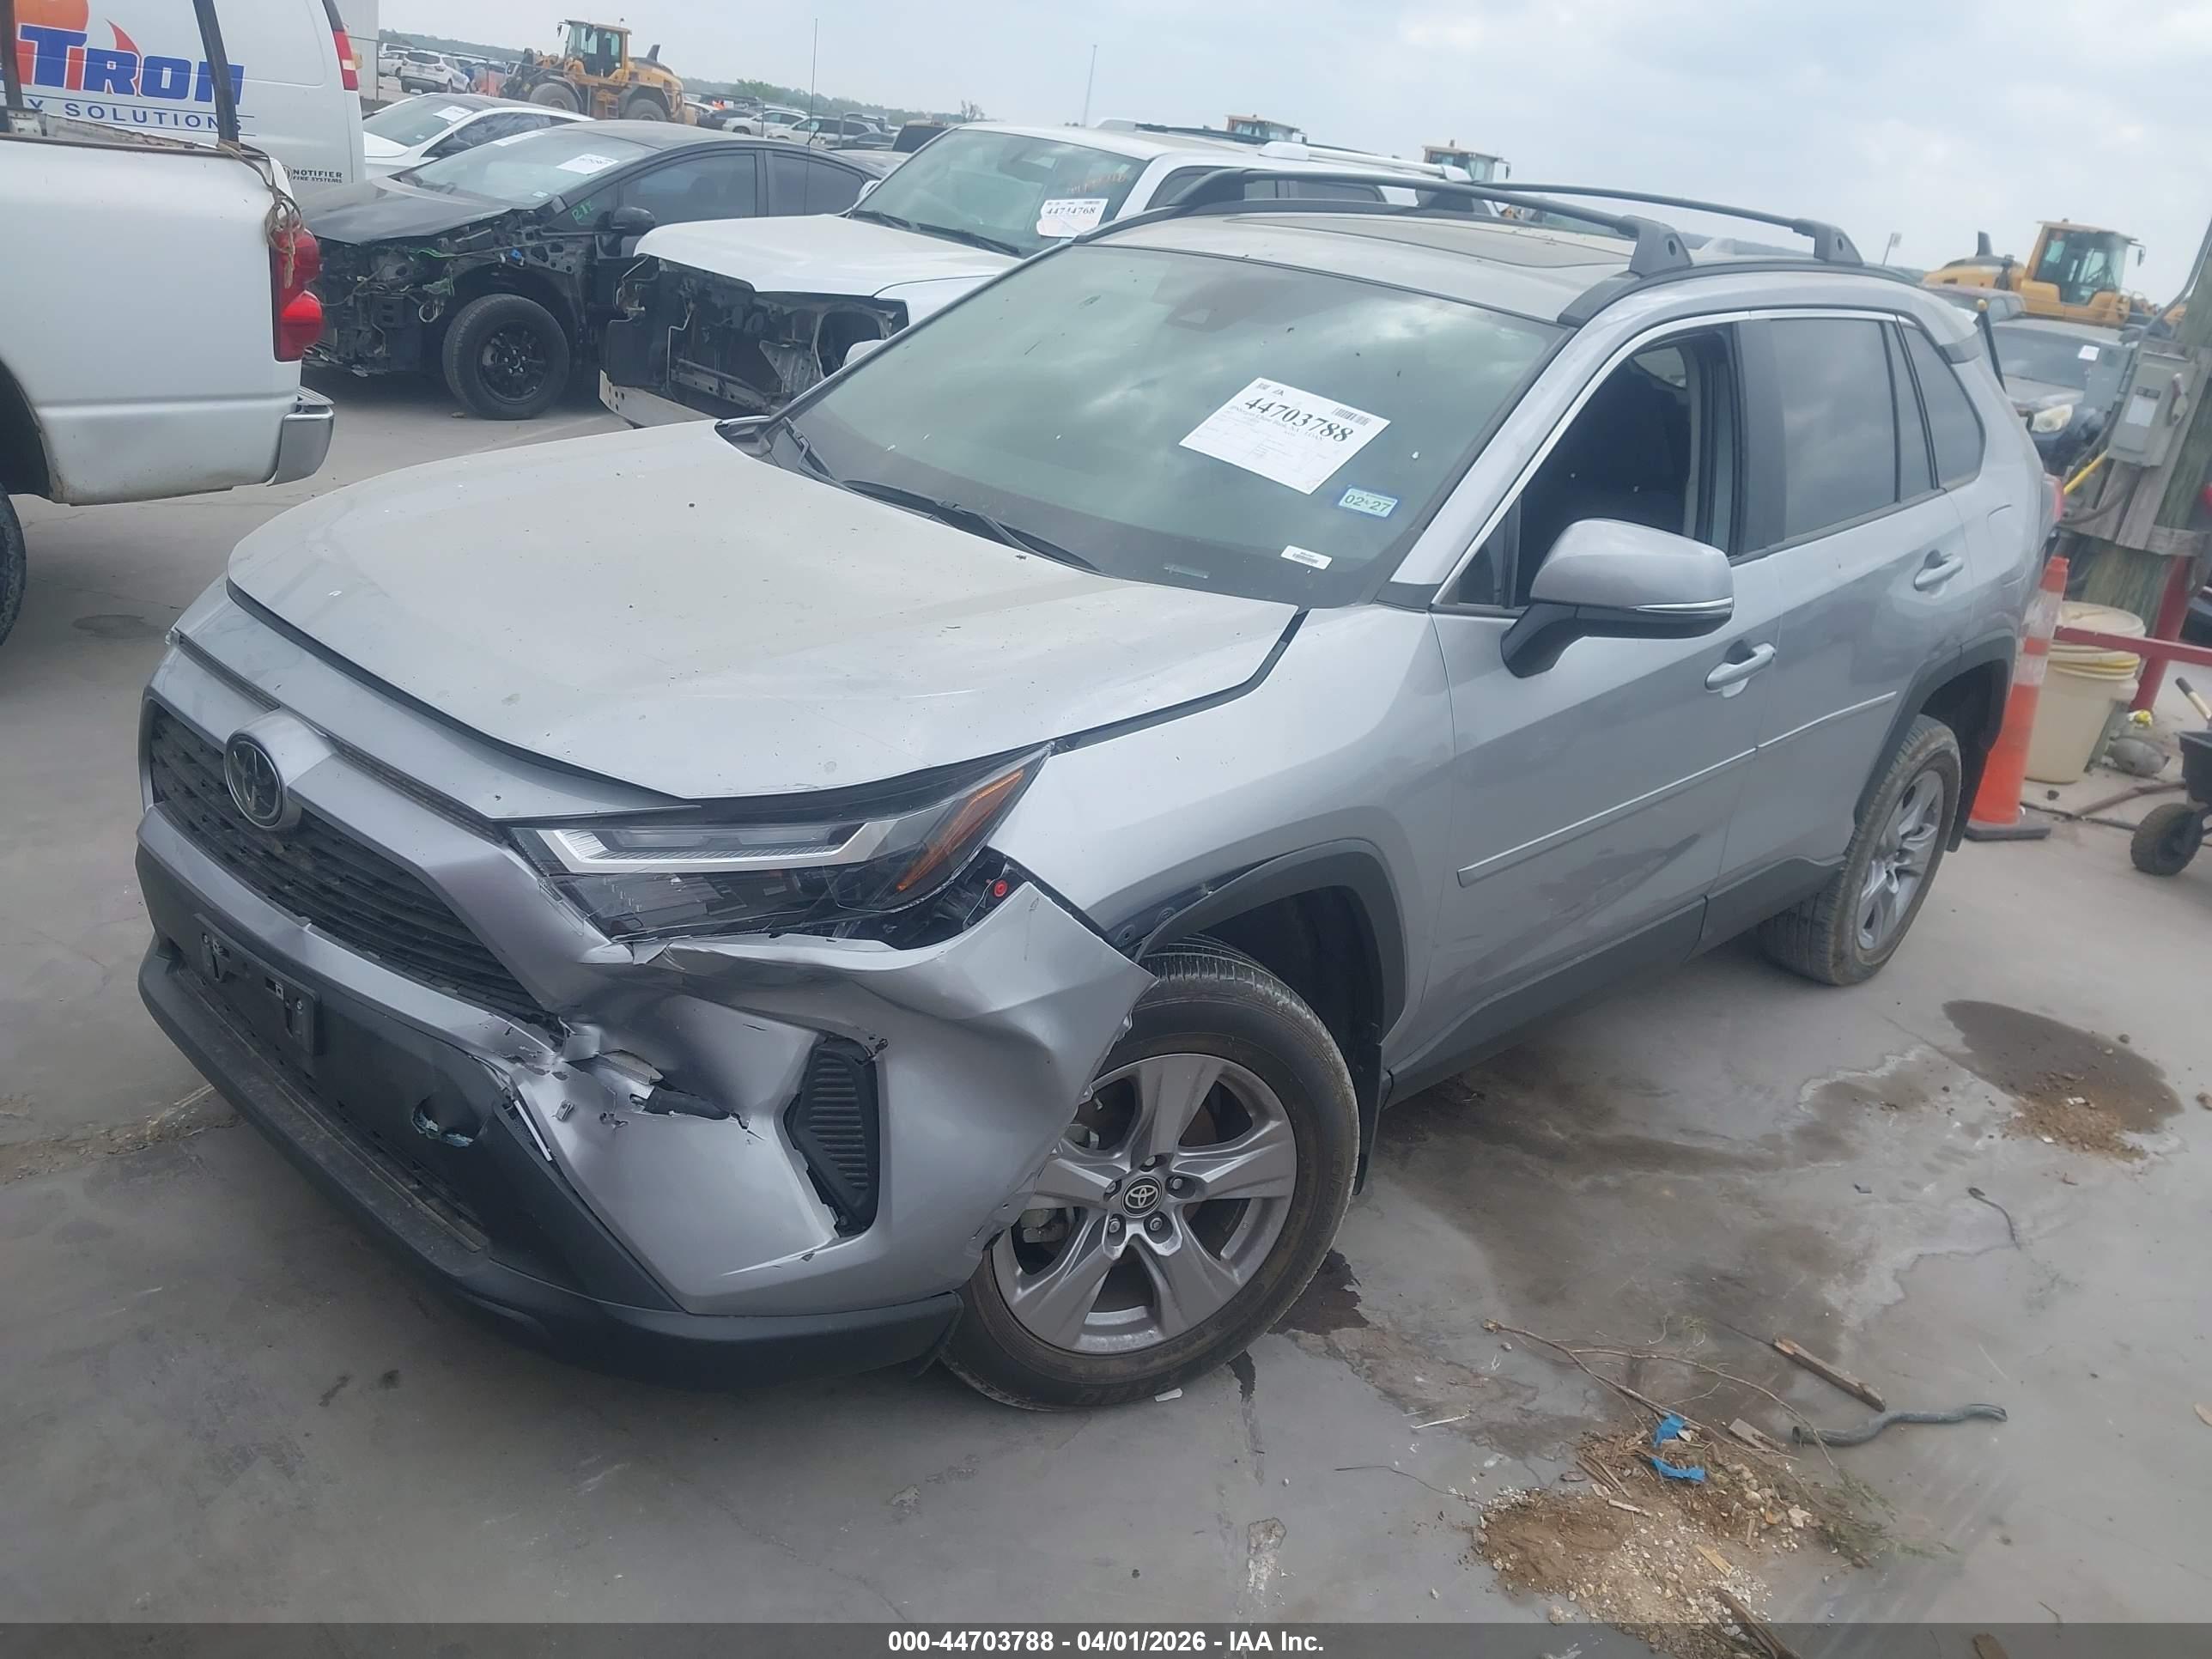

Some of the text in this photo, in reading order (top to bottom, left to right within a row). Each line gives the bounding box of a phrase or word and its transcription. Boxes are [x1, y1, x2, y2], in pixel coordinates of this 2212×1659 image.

[293, 169, 343, 179] NOTIFIER
[1245, 398, 1354, 442] 44703788
[1345, 495, 1392, 513] 02 27
